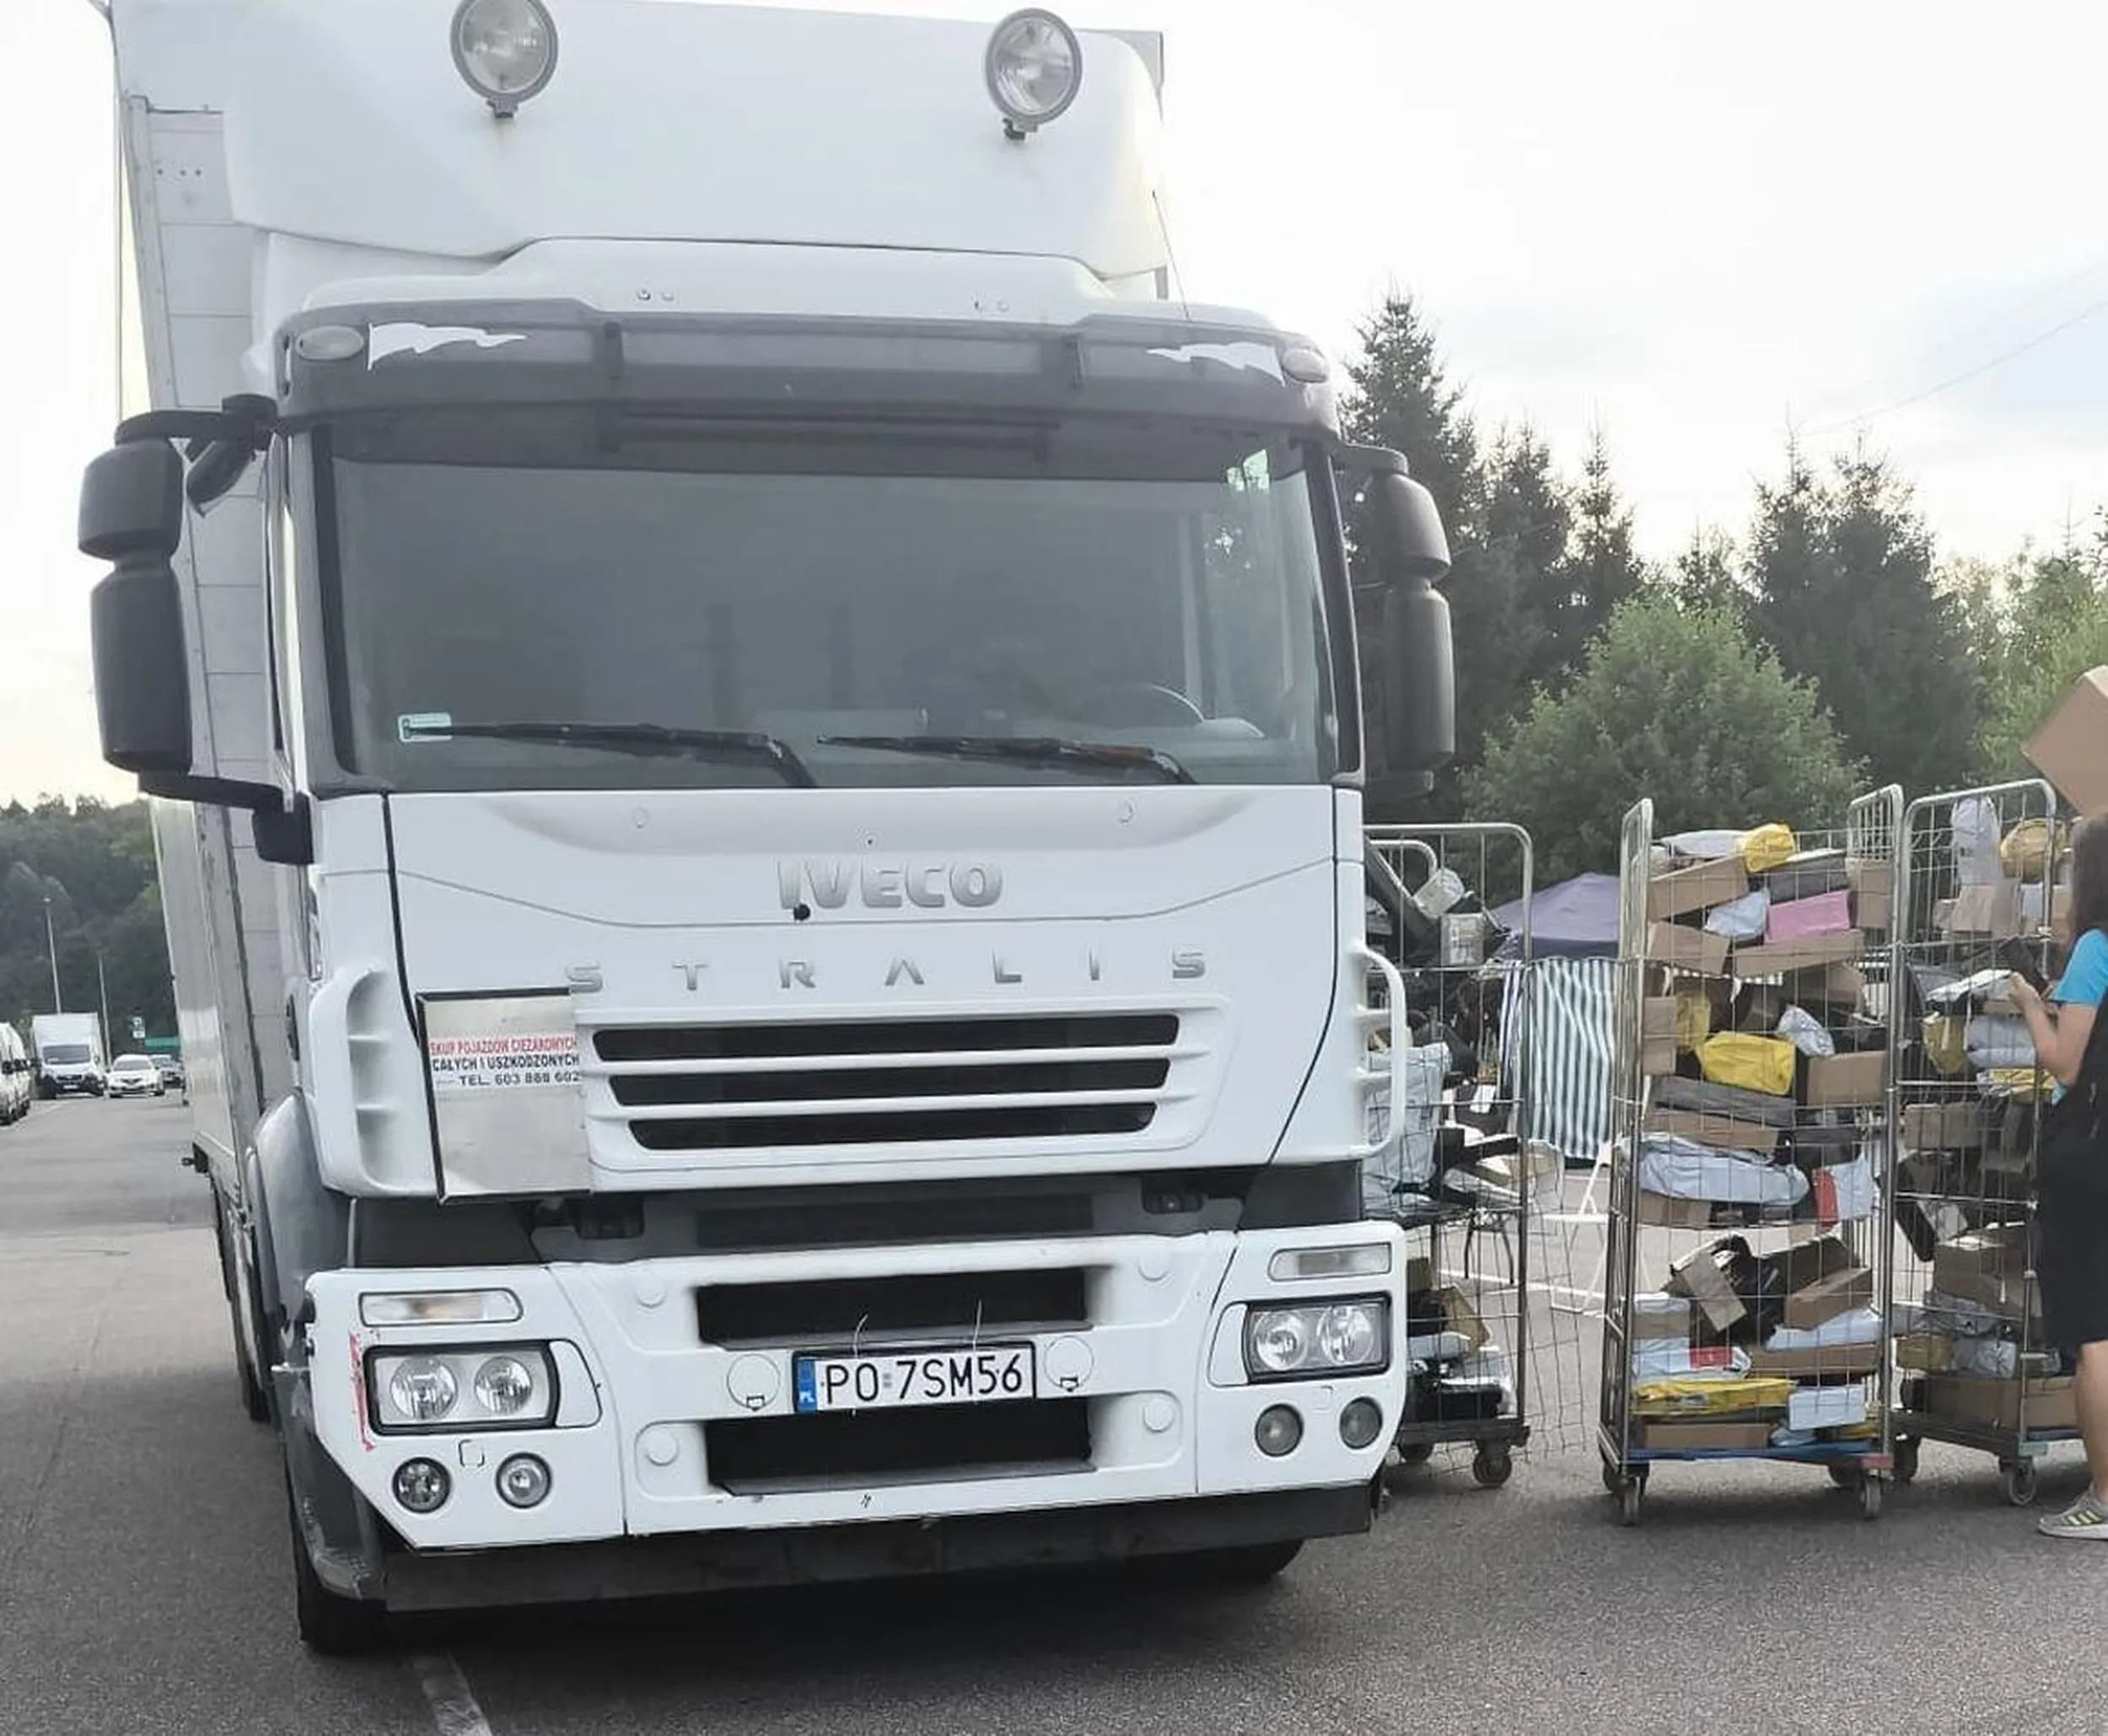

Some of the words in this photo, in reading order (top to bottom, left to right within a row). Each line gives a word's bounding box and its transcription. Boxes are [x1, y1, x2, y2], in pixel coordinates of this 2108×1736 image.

[777, 858, 1003, 909] IVECO
[564, 942, 1207, 994] STRALIS
[494, 1072, 521, 1086] 603
[896, 1353, 1023, 1400] 7SM56
